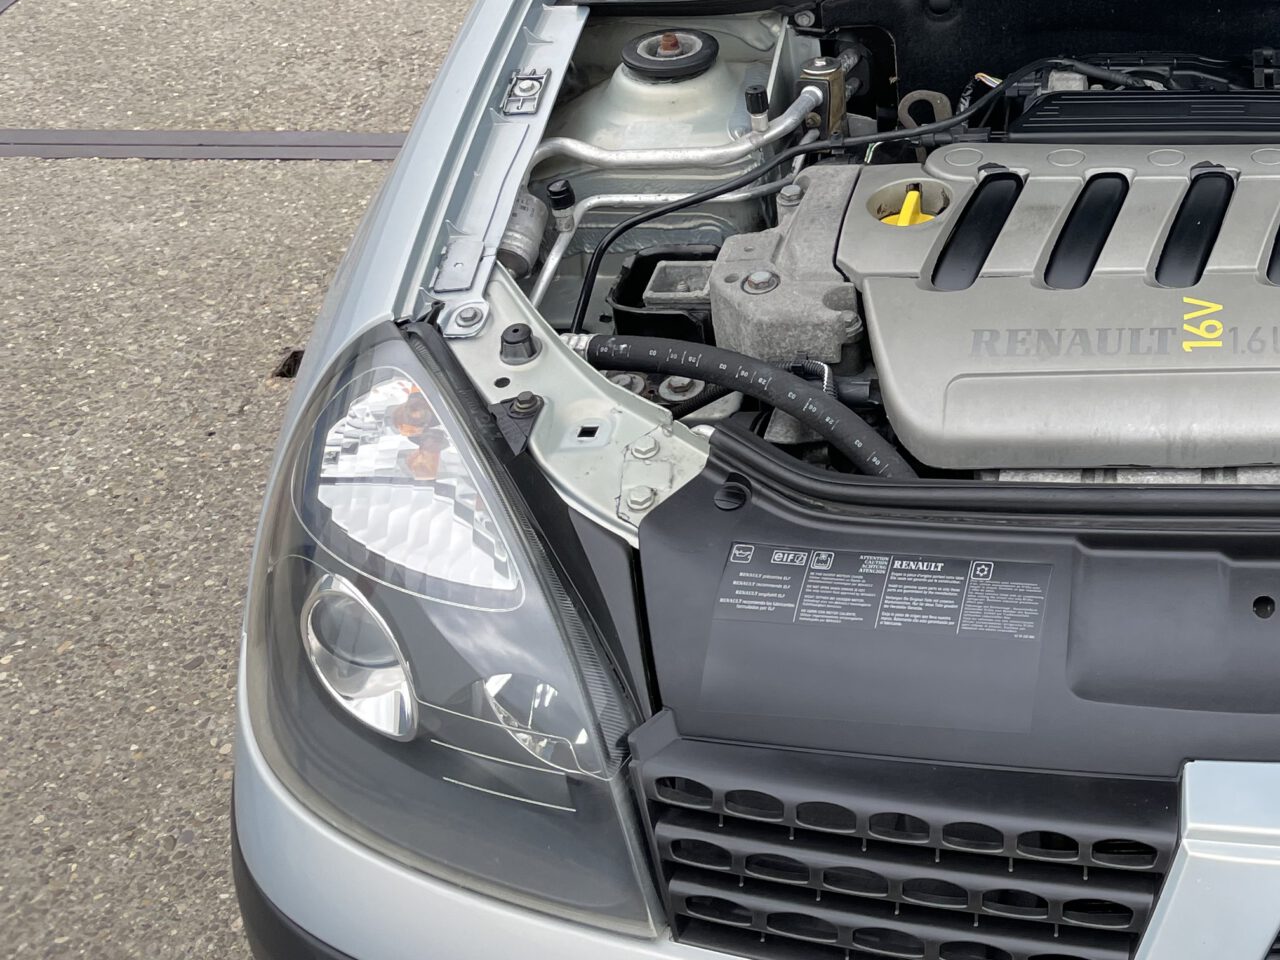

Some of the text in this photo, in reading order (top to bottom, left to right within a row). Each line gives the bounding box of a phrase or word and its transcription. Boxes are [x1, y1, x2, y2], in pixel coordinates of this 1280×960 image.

[970, 327, 1176, 358] RENAULT
[1182, 297, 1224, 352] 16V
[859, 554, 889, 562] ATTENTION
[893, 559, 944, 573] RENAULT
